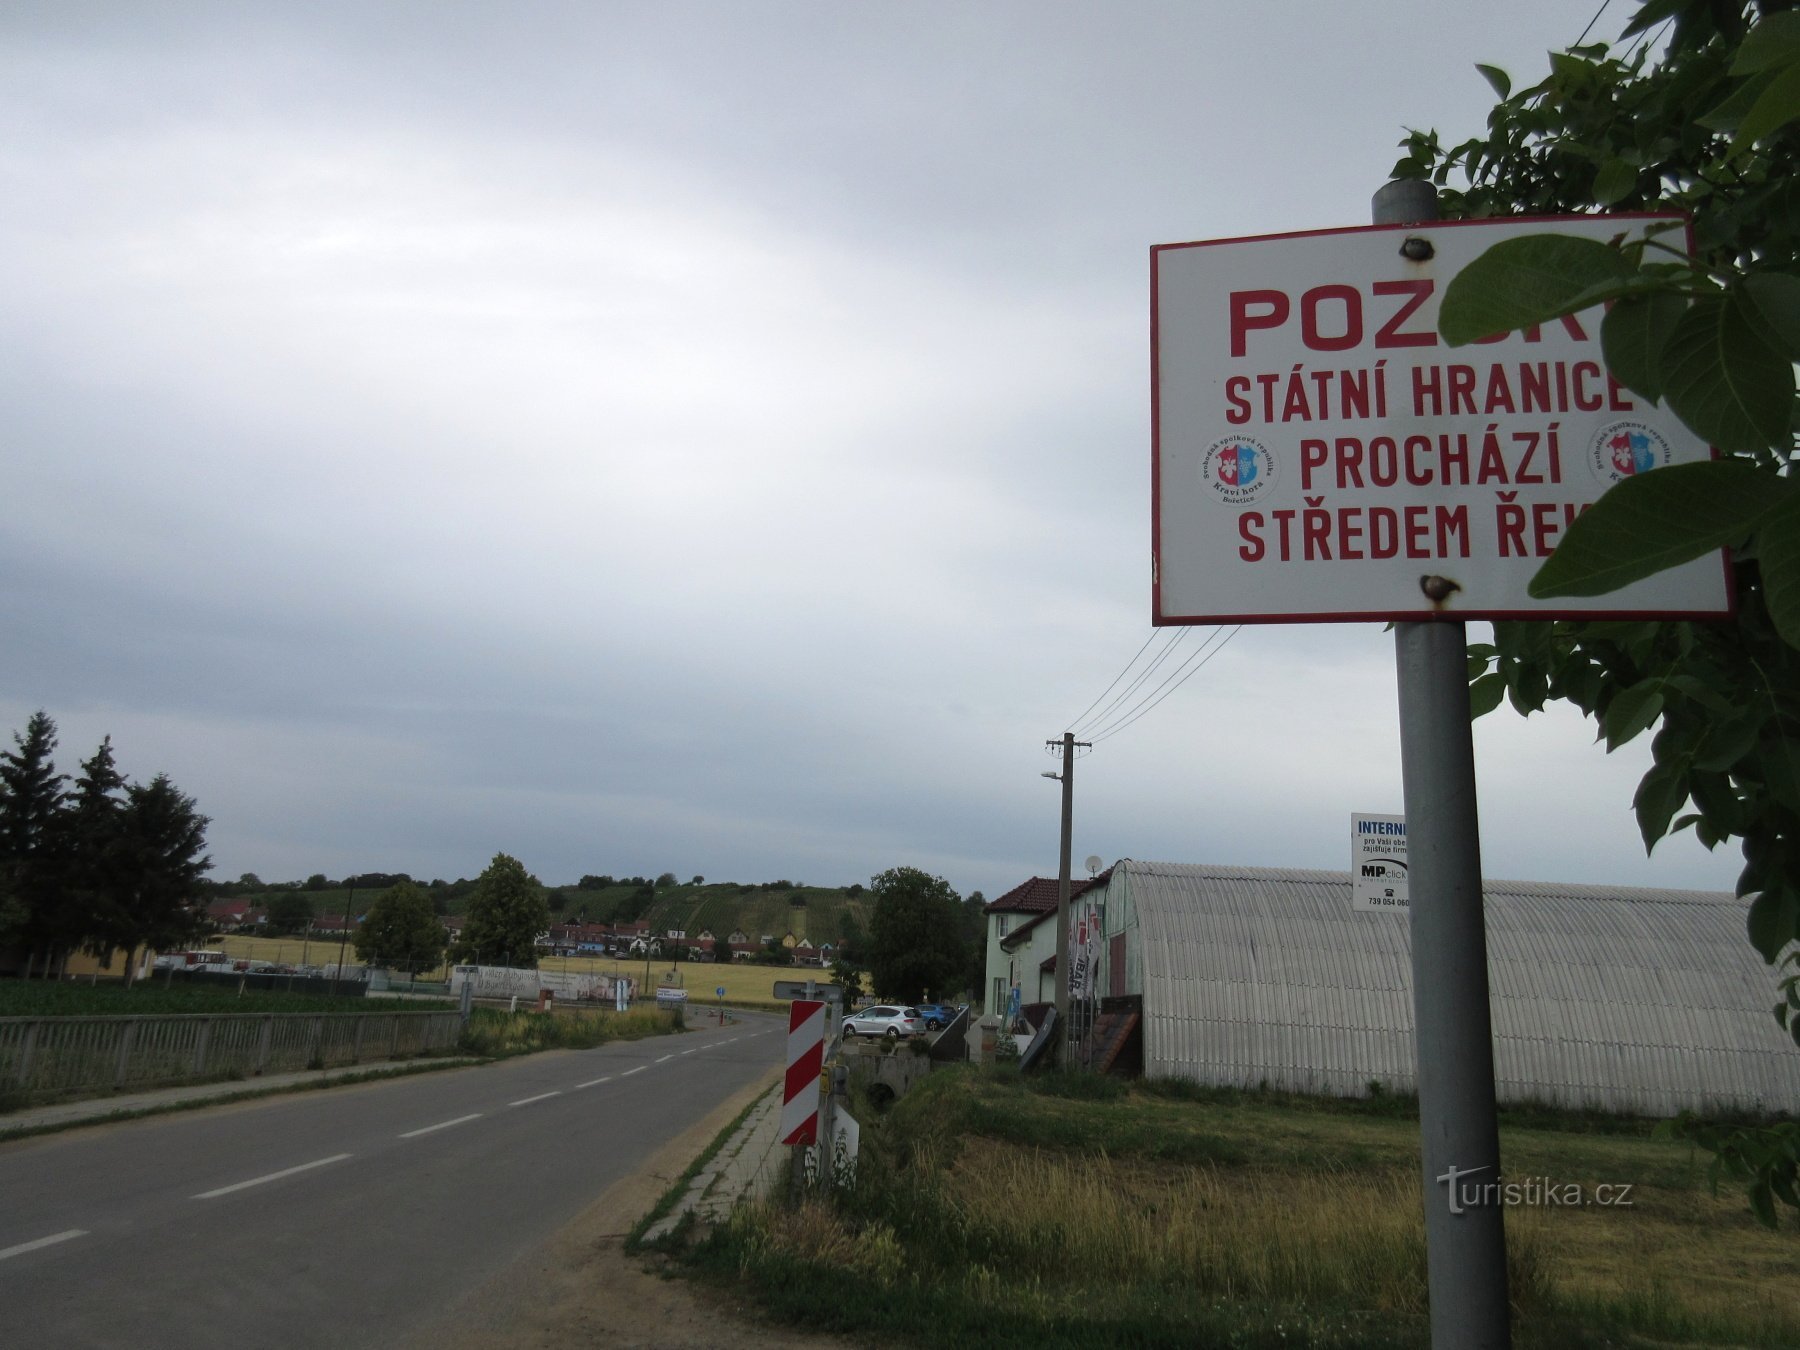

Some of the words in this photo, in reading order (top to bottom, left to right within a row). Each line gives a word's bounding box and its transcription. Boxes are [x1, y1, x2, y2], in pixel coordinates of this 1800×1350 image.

[1225, 359, 1387, 424] STÁTNÍ
[1413, 361, 1635, 417] HRANICE
[1219, 435, 1256, 445] spolková
[1256, 442, 1274, 477] republika
[1300, 422, 1562, 491] PROCHÁZÍ
[1213, 481, 1239, 496] Kraví
[1242, 481, 1264, 496] hora
[1238, 496, 1471, 564] STŘEDEM
[1377, 837, 1391, 845] Vaši
[1369, 897, 1381, 906] 739
[1383, 898, 1395, 906] 054
